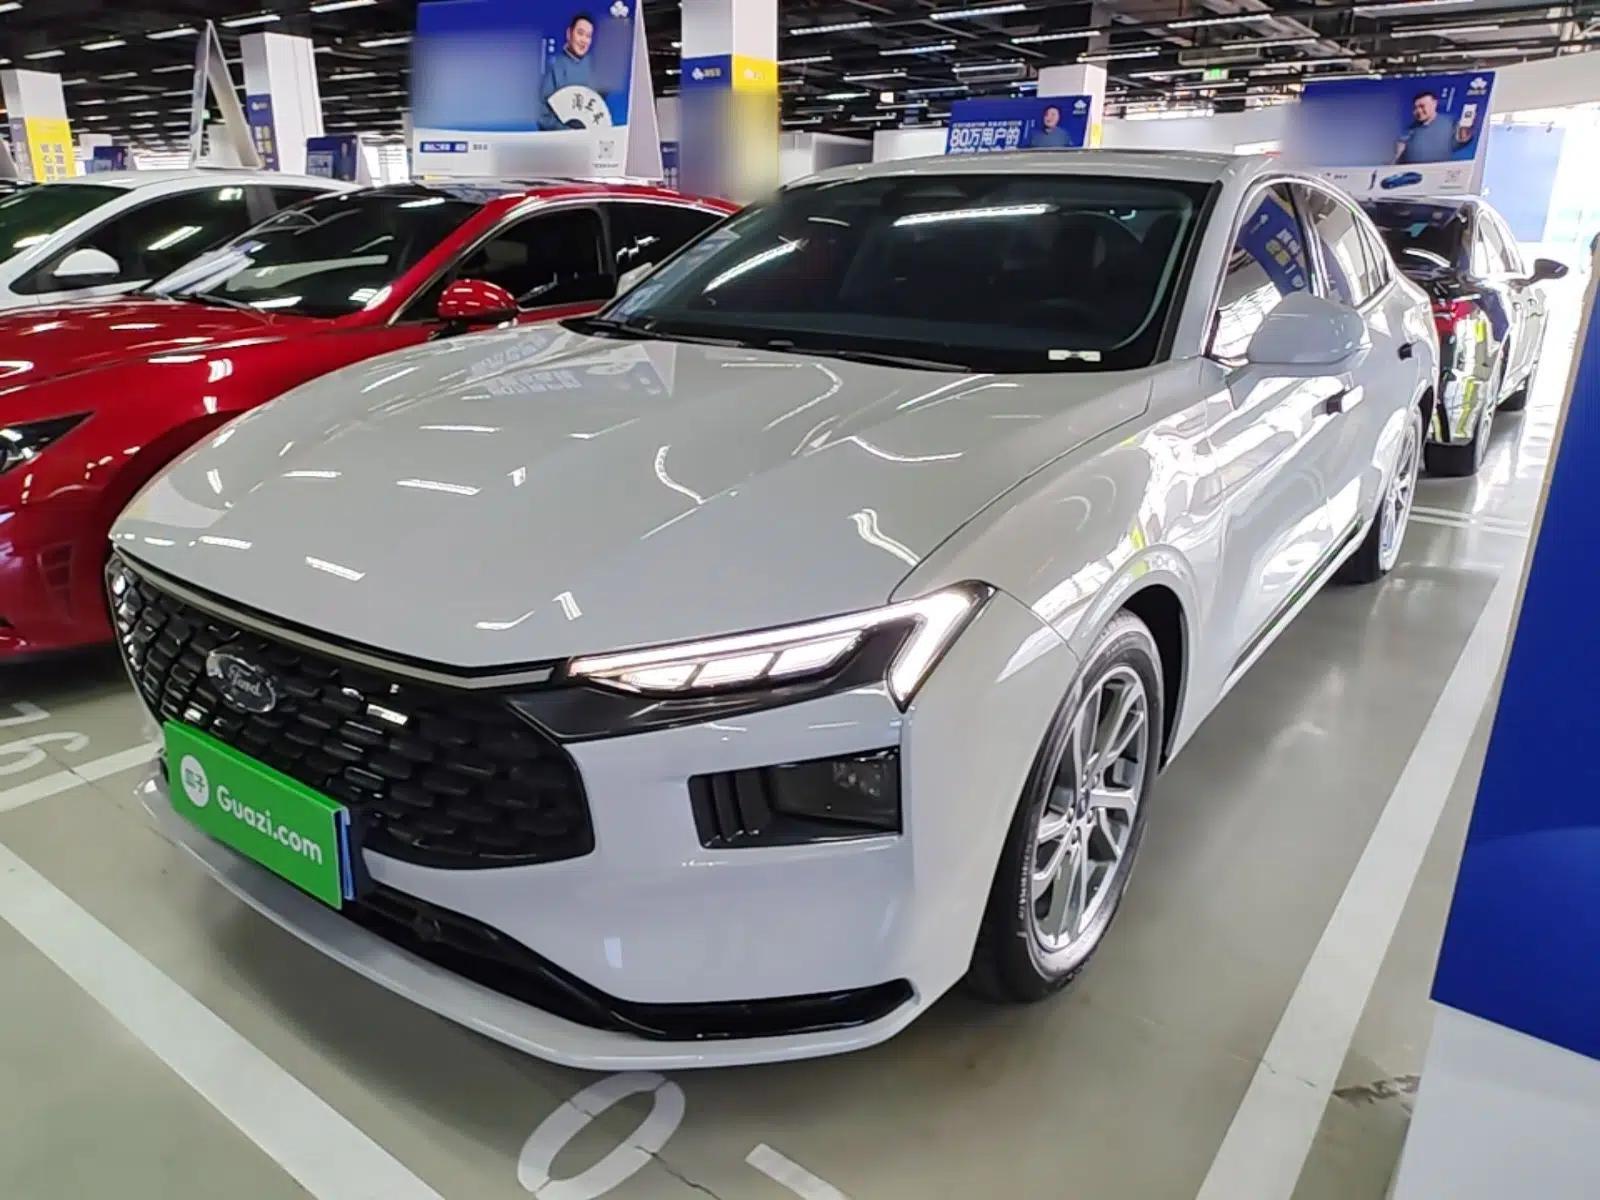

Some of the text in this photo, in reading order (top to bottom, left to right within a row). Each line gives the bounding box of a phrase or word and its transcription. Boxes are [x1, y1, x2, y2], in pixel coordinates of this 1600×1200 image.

[950, 127, 1020, 147] 80万用户的
[216, 785, 323, 865] Guazi.com
